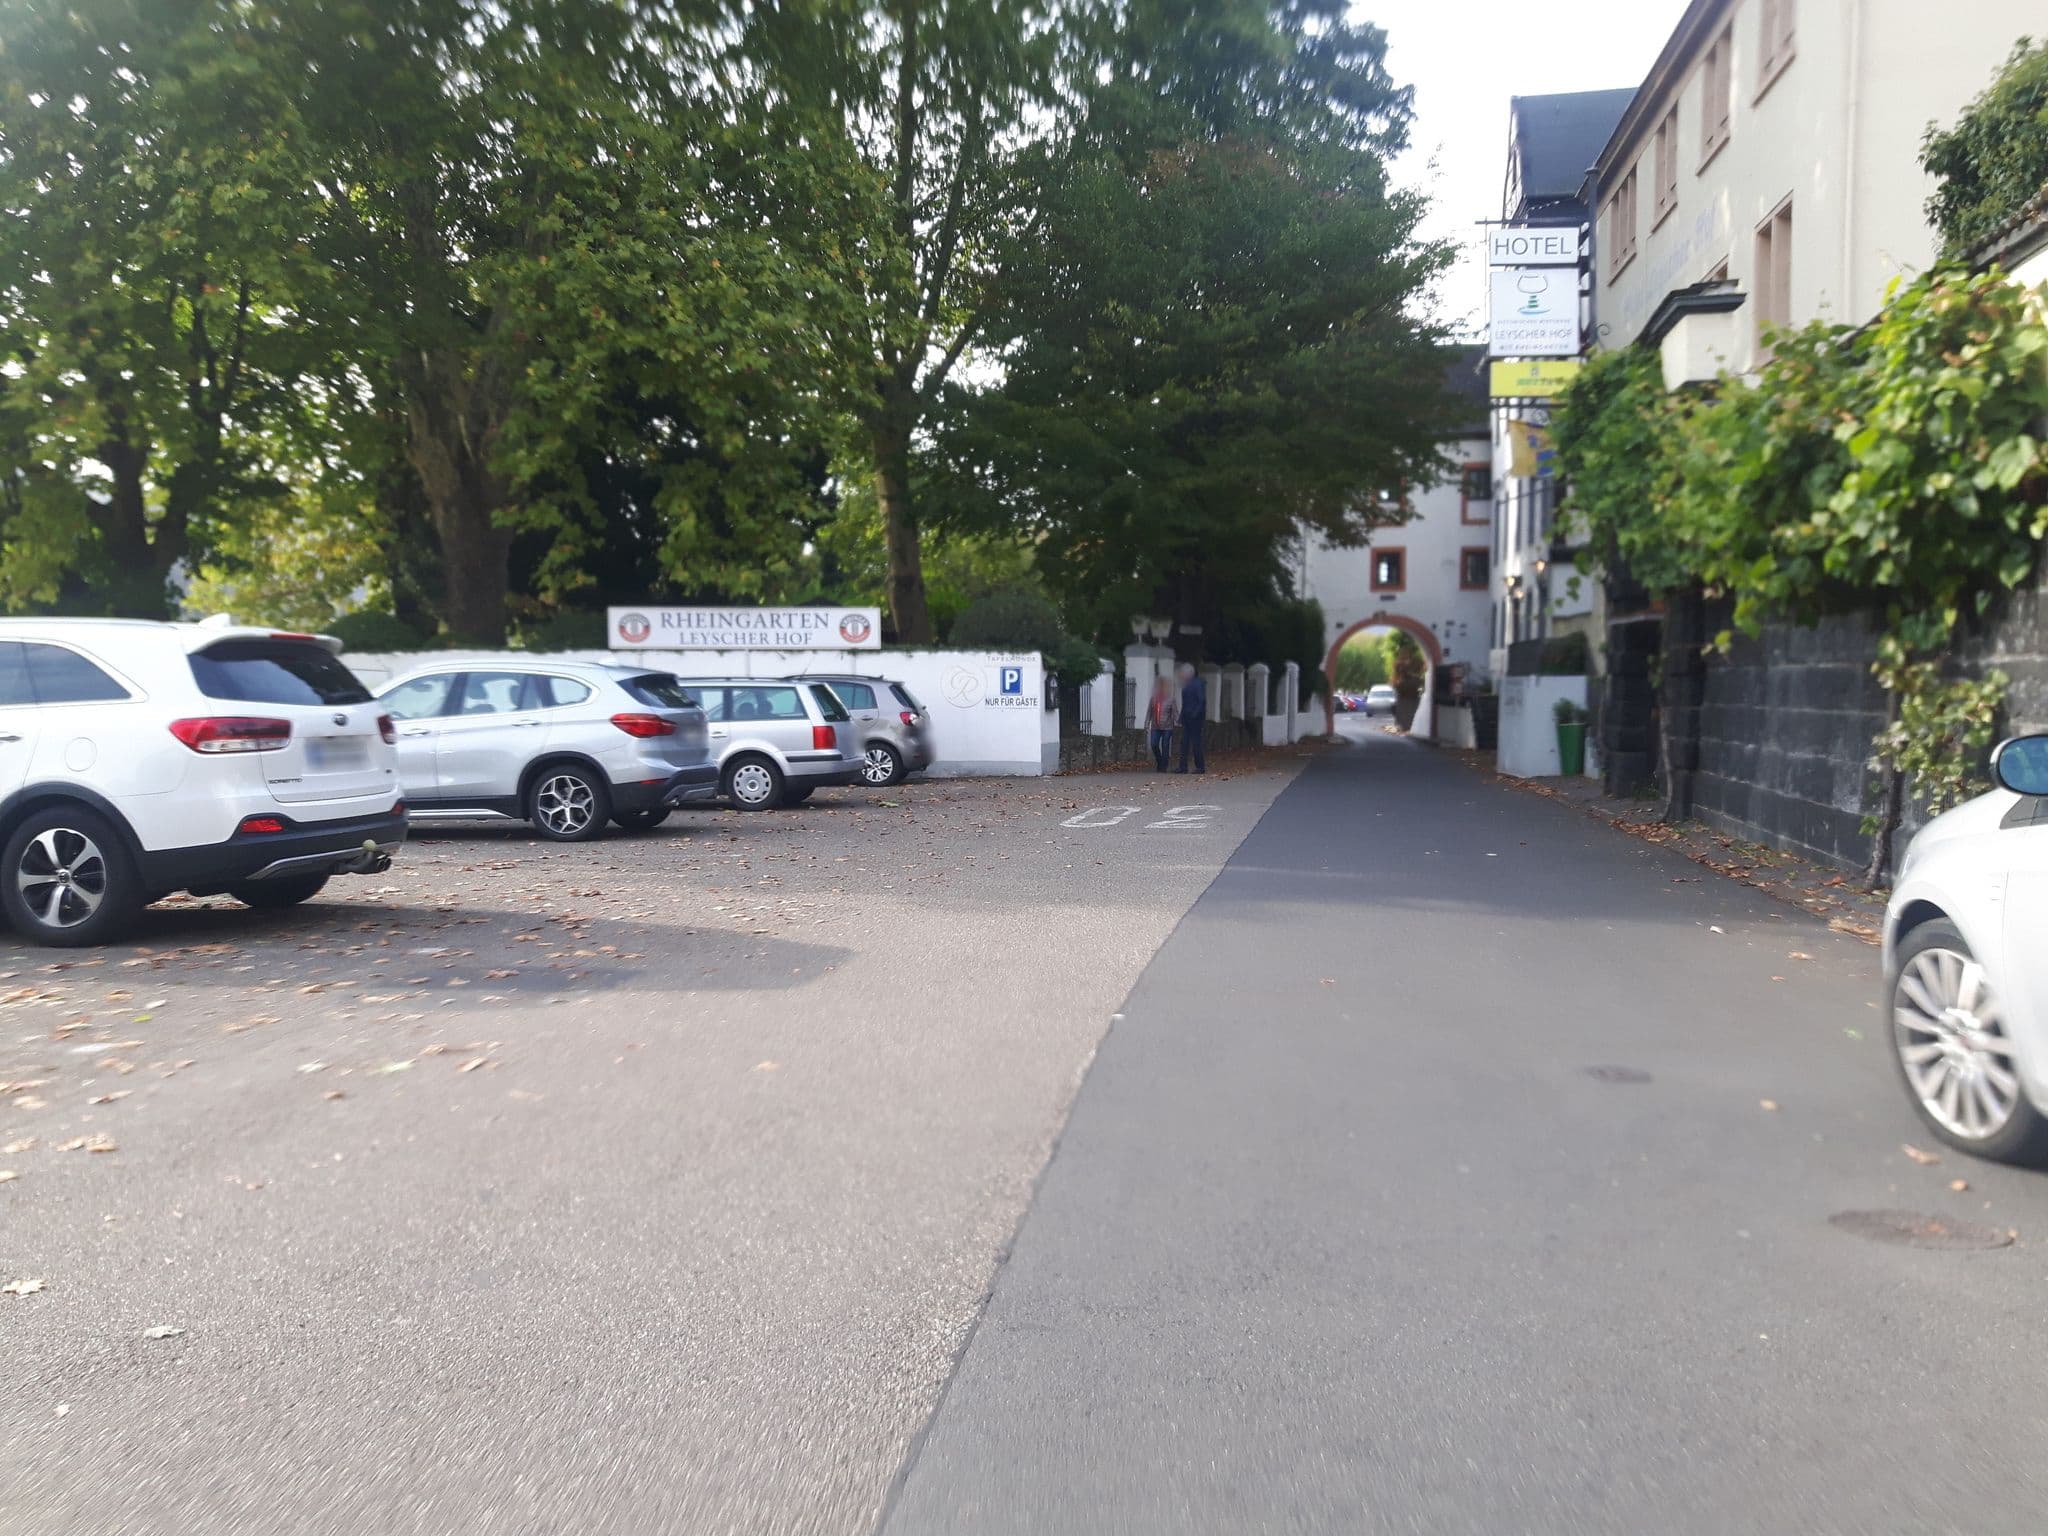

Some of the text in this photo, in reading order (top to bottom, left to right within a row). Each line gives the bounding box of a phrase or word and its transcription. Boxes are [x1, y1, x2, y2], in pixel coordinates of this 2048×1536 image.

[1494, 237, 1572, 256] HOTEL
[1549, 329, 1573, 339] HOF
[660, 611, 830, 630] RHEINGARTEN
[679, 632, 813, 646] LEYSCHER HOF
[1006, 670, 1018, 690] P
[984, 696, 1037, 706] NUR FÜR GÄSTE
